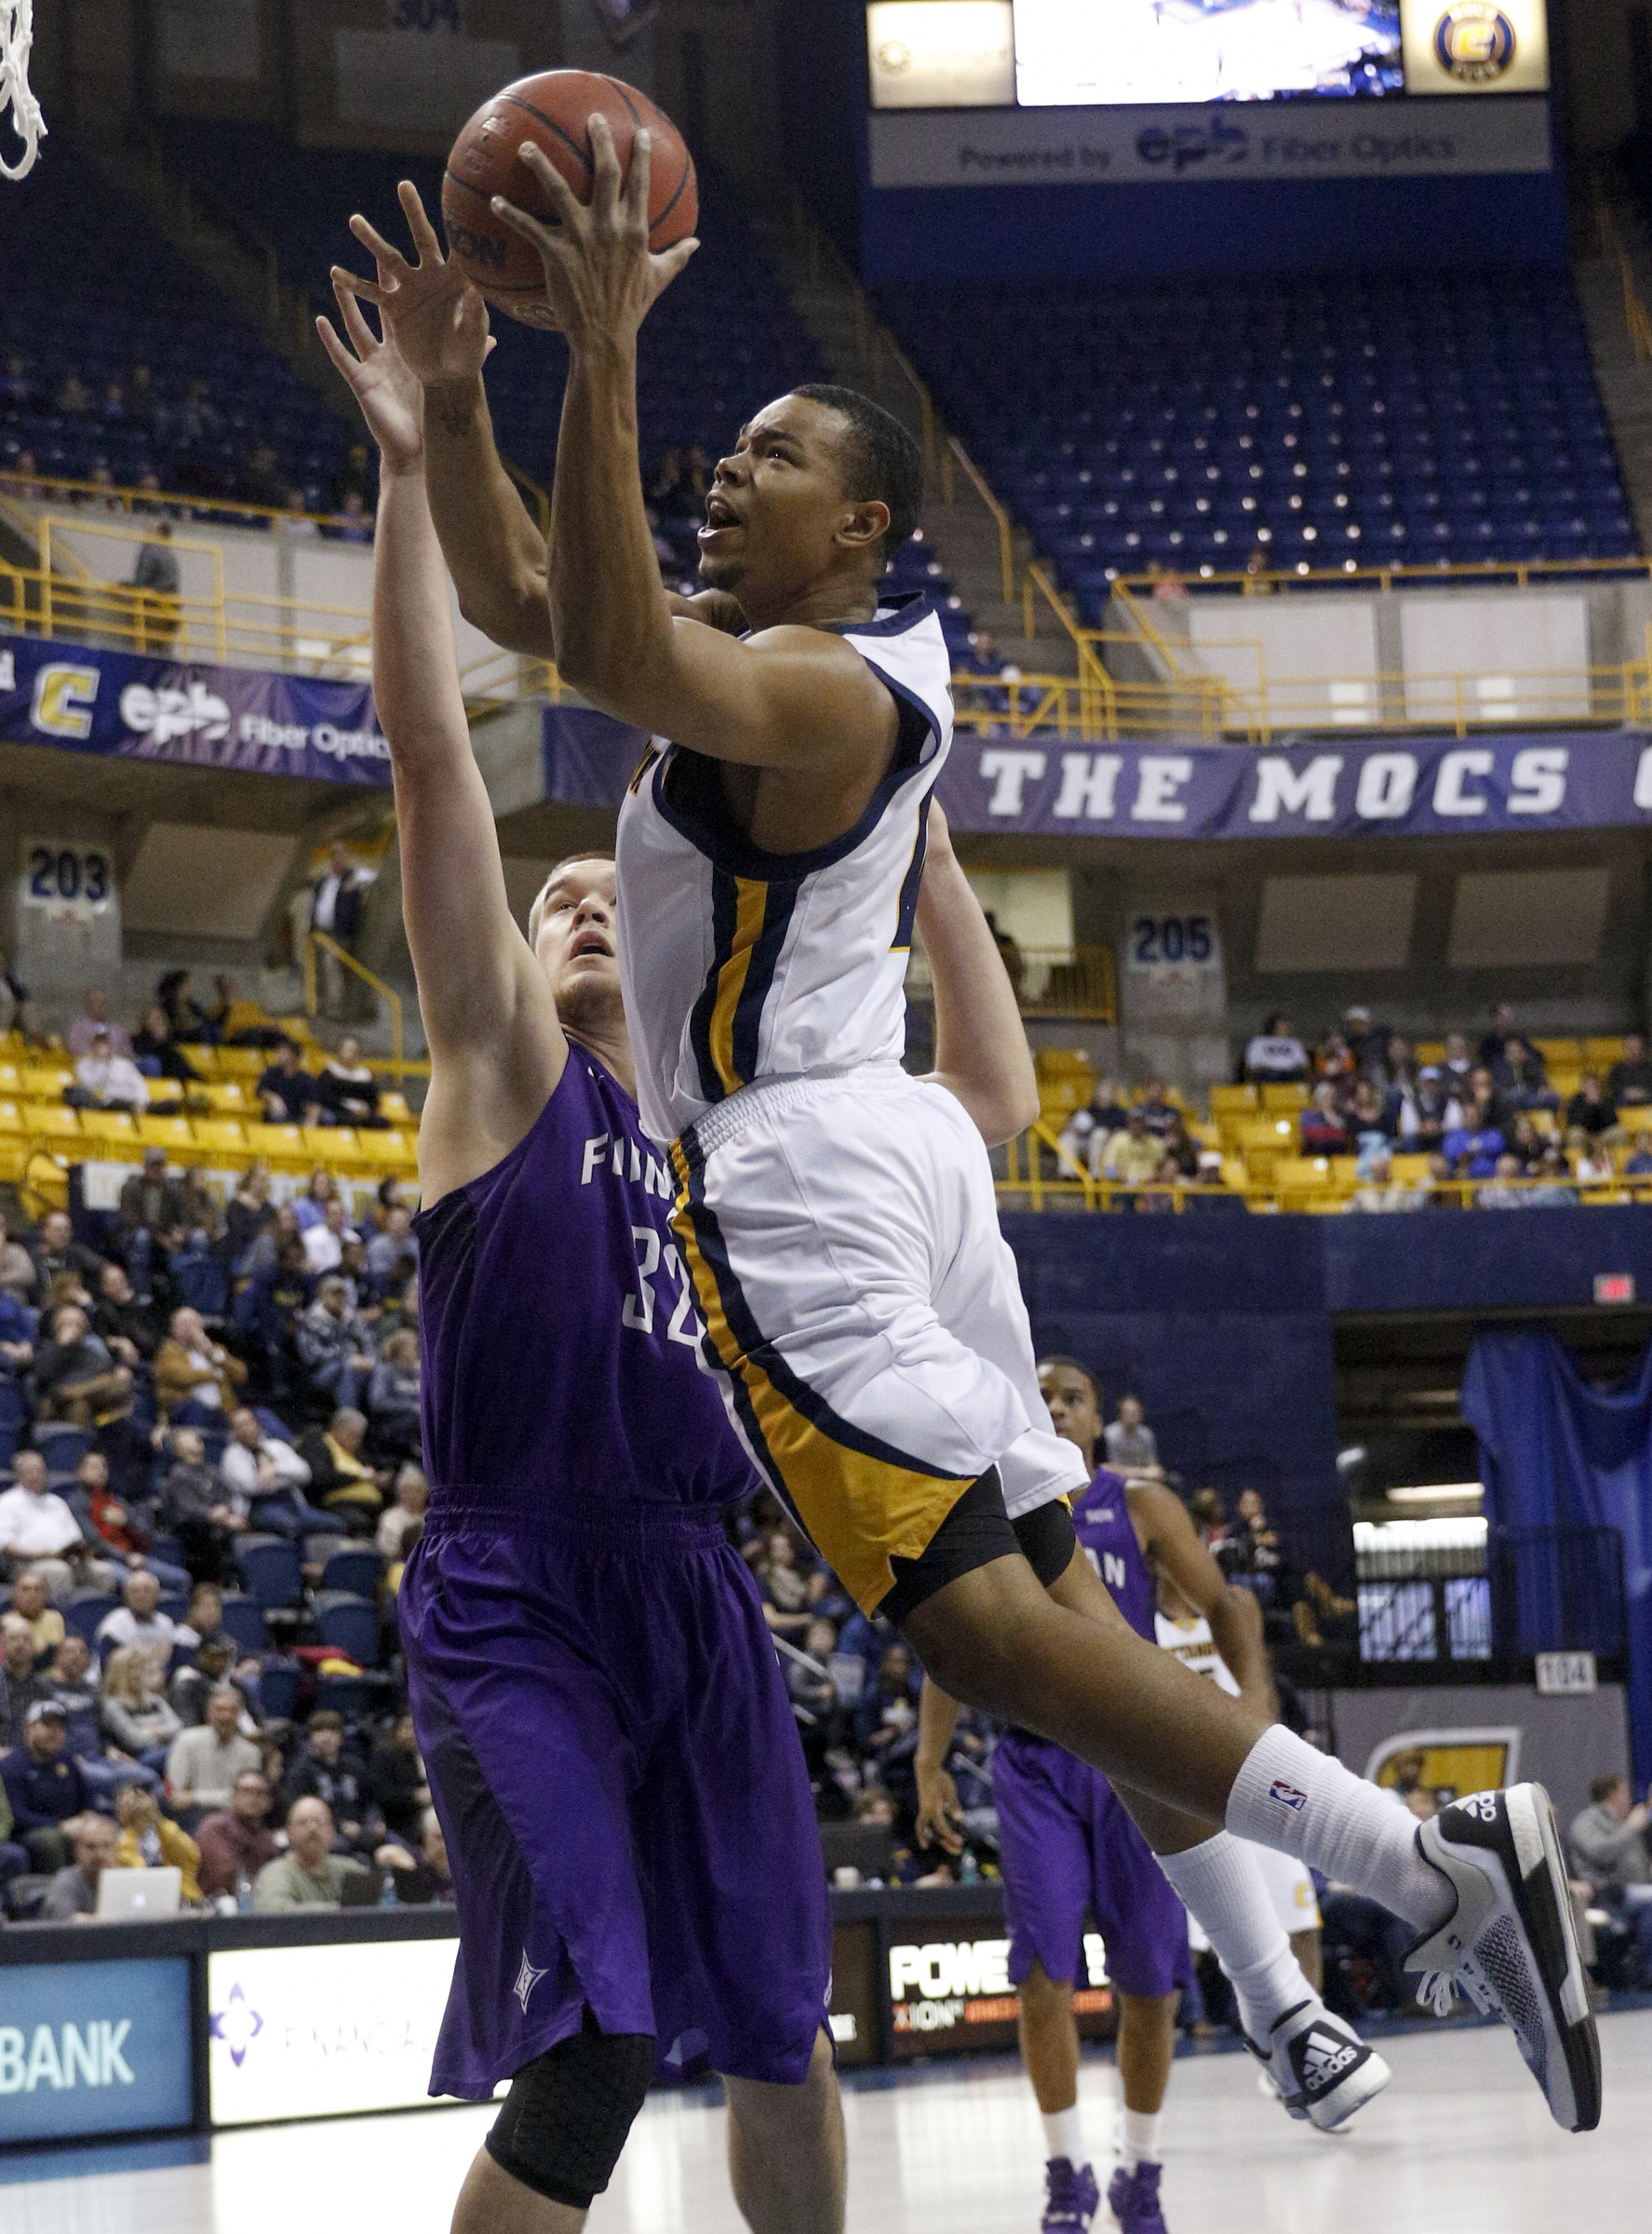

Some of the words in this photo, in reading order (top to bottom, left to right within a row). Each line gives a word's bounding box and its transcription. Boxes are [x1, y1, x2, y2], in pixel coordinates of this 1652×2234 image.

[960, 146, 1072, 169] Powered
[1081, 143, 1112, 171] by
[1262, 133, 1340, 162] Fiber
[1350, 130, 1456, 165] Optics
[30, 661, 101, 740] C
[119, 682, 232, 745] epb
[239, 714, 308, 749] Fiber
[311, 721, 391, 761] Optic
[979, 749, 1194, 822] THE
[1248, 747, 1570, 824] MOCS
[30, 846, 108, 901] 203
[1135, 915, 1213, 962] 205
[0, 2018, 136, 2094] BANK
[285, 2020, 429, 2057] FNANCAL
[1305, 2045, 1358, 2091] adidas
